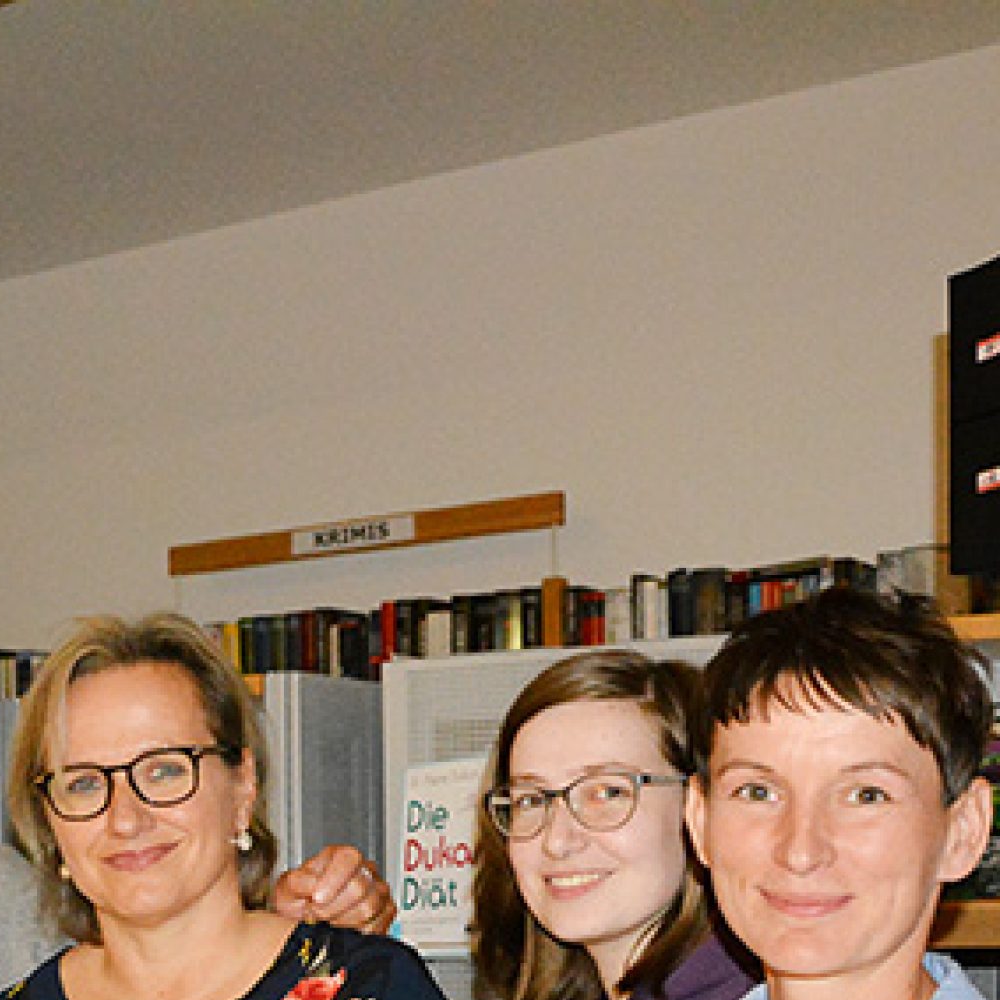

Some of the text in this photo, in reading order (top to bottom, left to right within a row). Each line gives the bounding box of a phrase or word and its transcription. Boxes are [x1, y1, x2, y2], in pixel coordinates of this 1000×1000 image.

[406, 800, 450, 832] Die
[403, 836, 477, 872] Duka
[402, 877, 458, 910] Diät
